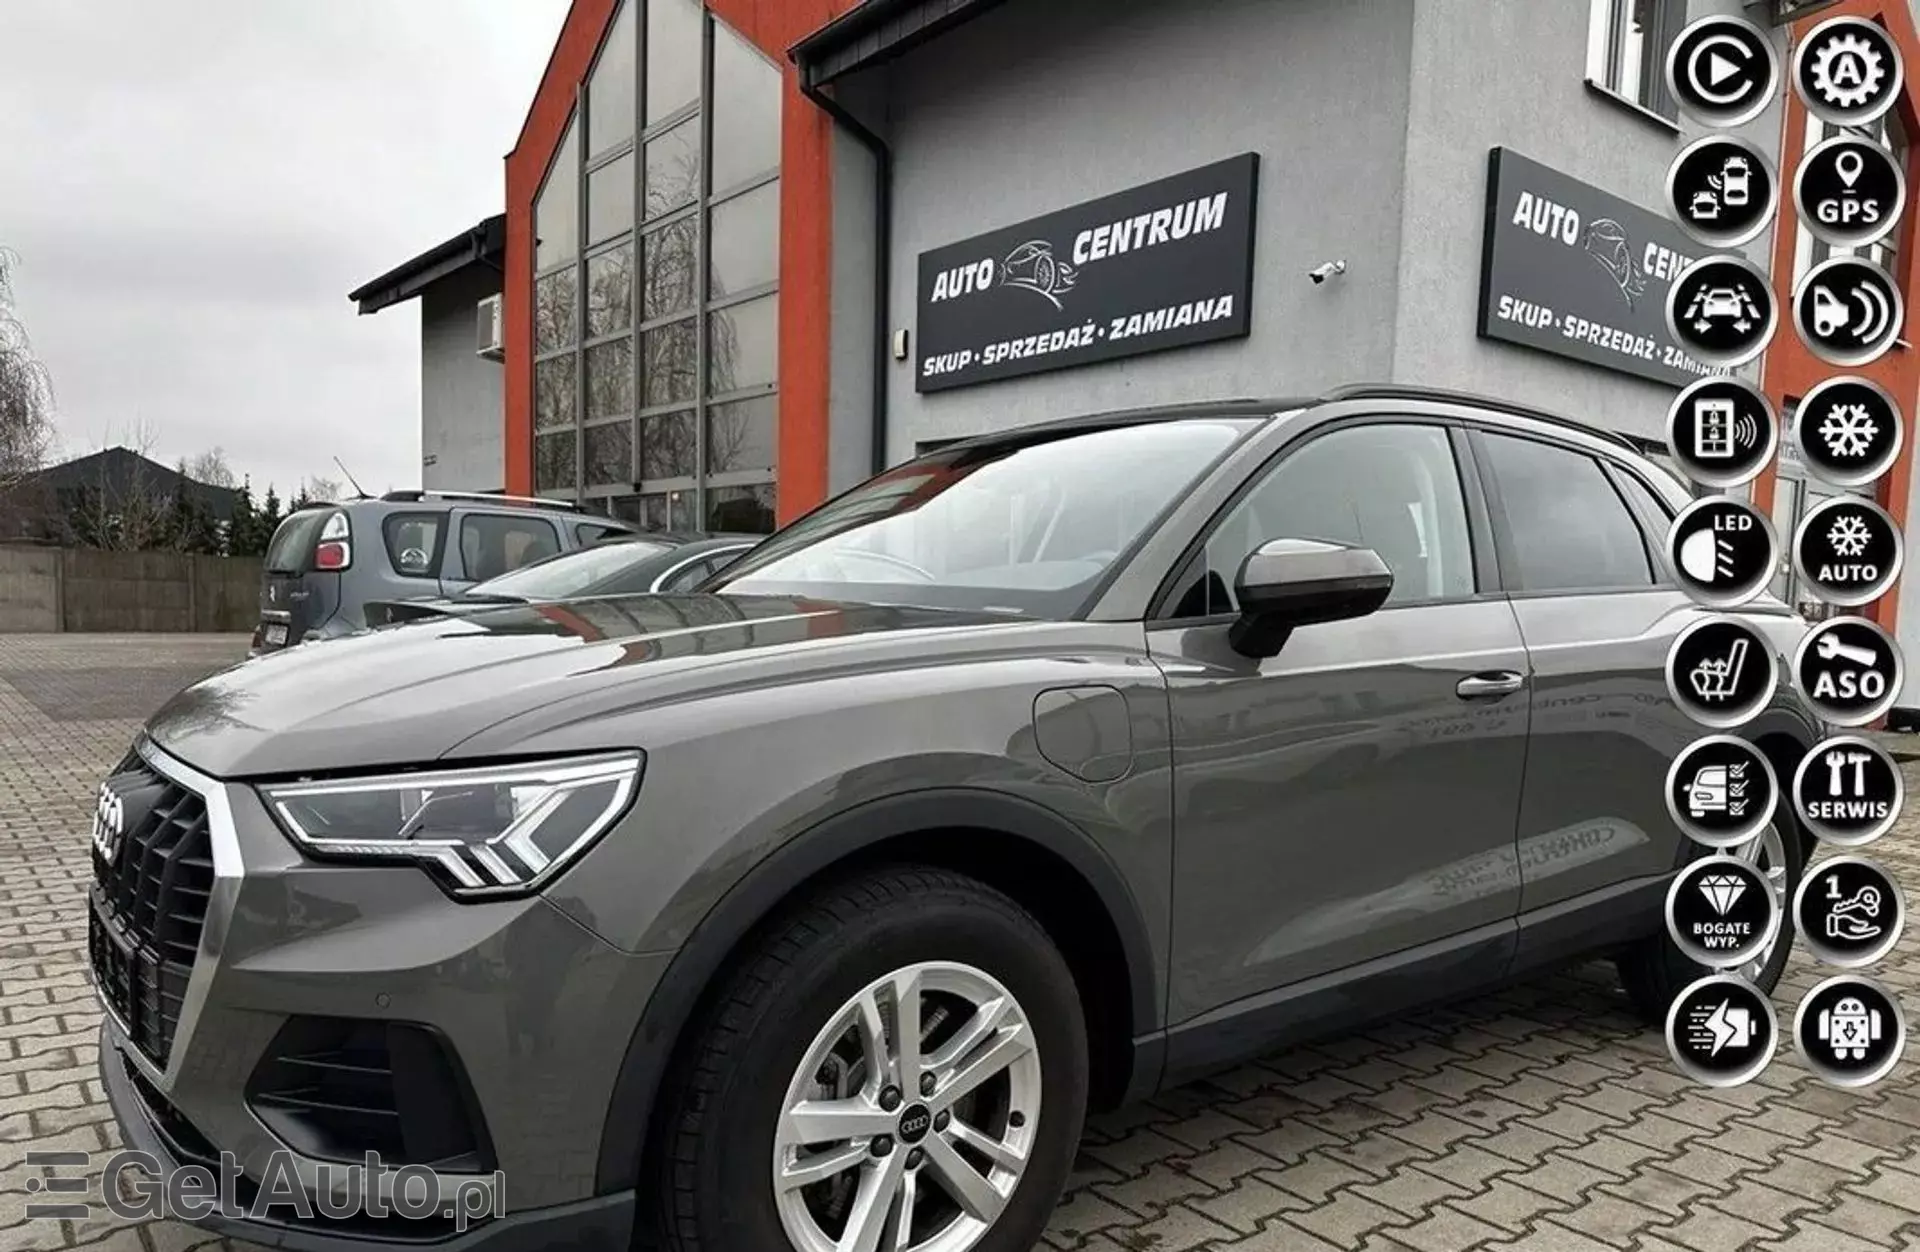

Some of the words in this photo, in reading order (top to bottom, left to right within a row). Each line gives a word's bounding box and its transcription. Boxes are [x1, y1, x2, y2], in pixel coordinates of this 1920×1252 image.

[931, 258, 994, 302] AUTO
[1072, 192, 1228, 266] CENTRUM
[1512, 190, 1580, 247] AUTO
[923, 350, 972, 377] SKUP
[983, 318, 1096, 366] SPRZEDAŻ
[1108, 295, 1234, 341] ZAMIANA
[1497, 295, 1553, 330] SKUP
[1562, 314, 1655, 361] SPRZEDAŻ
